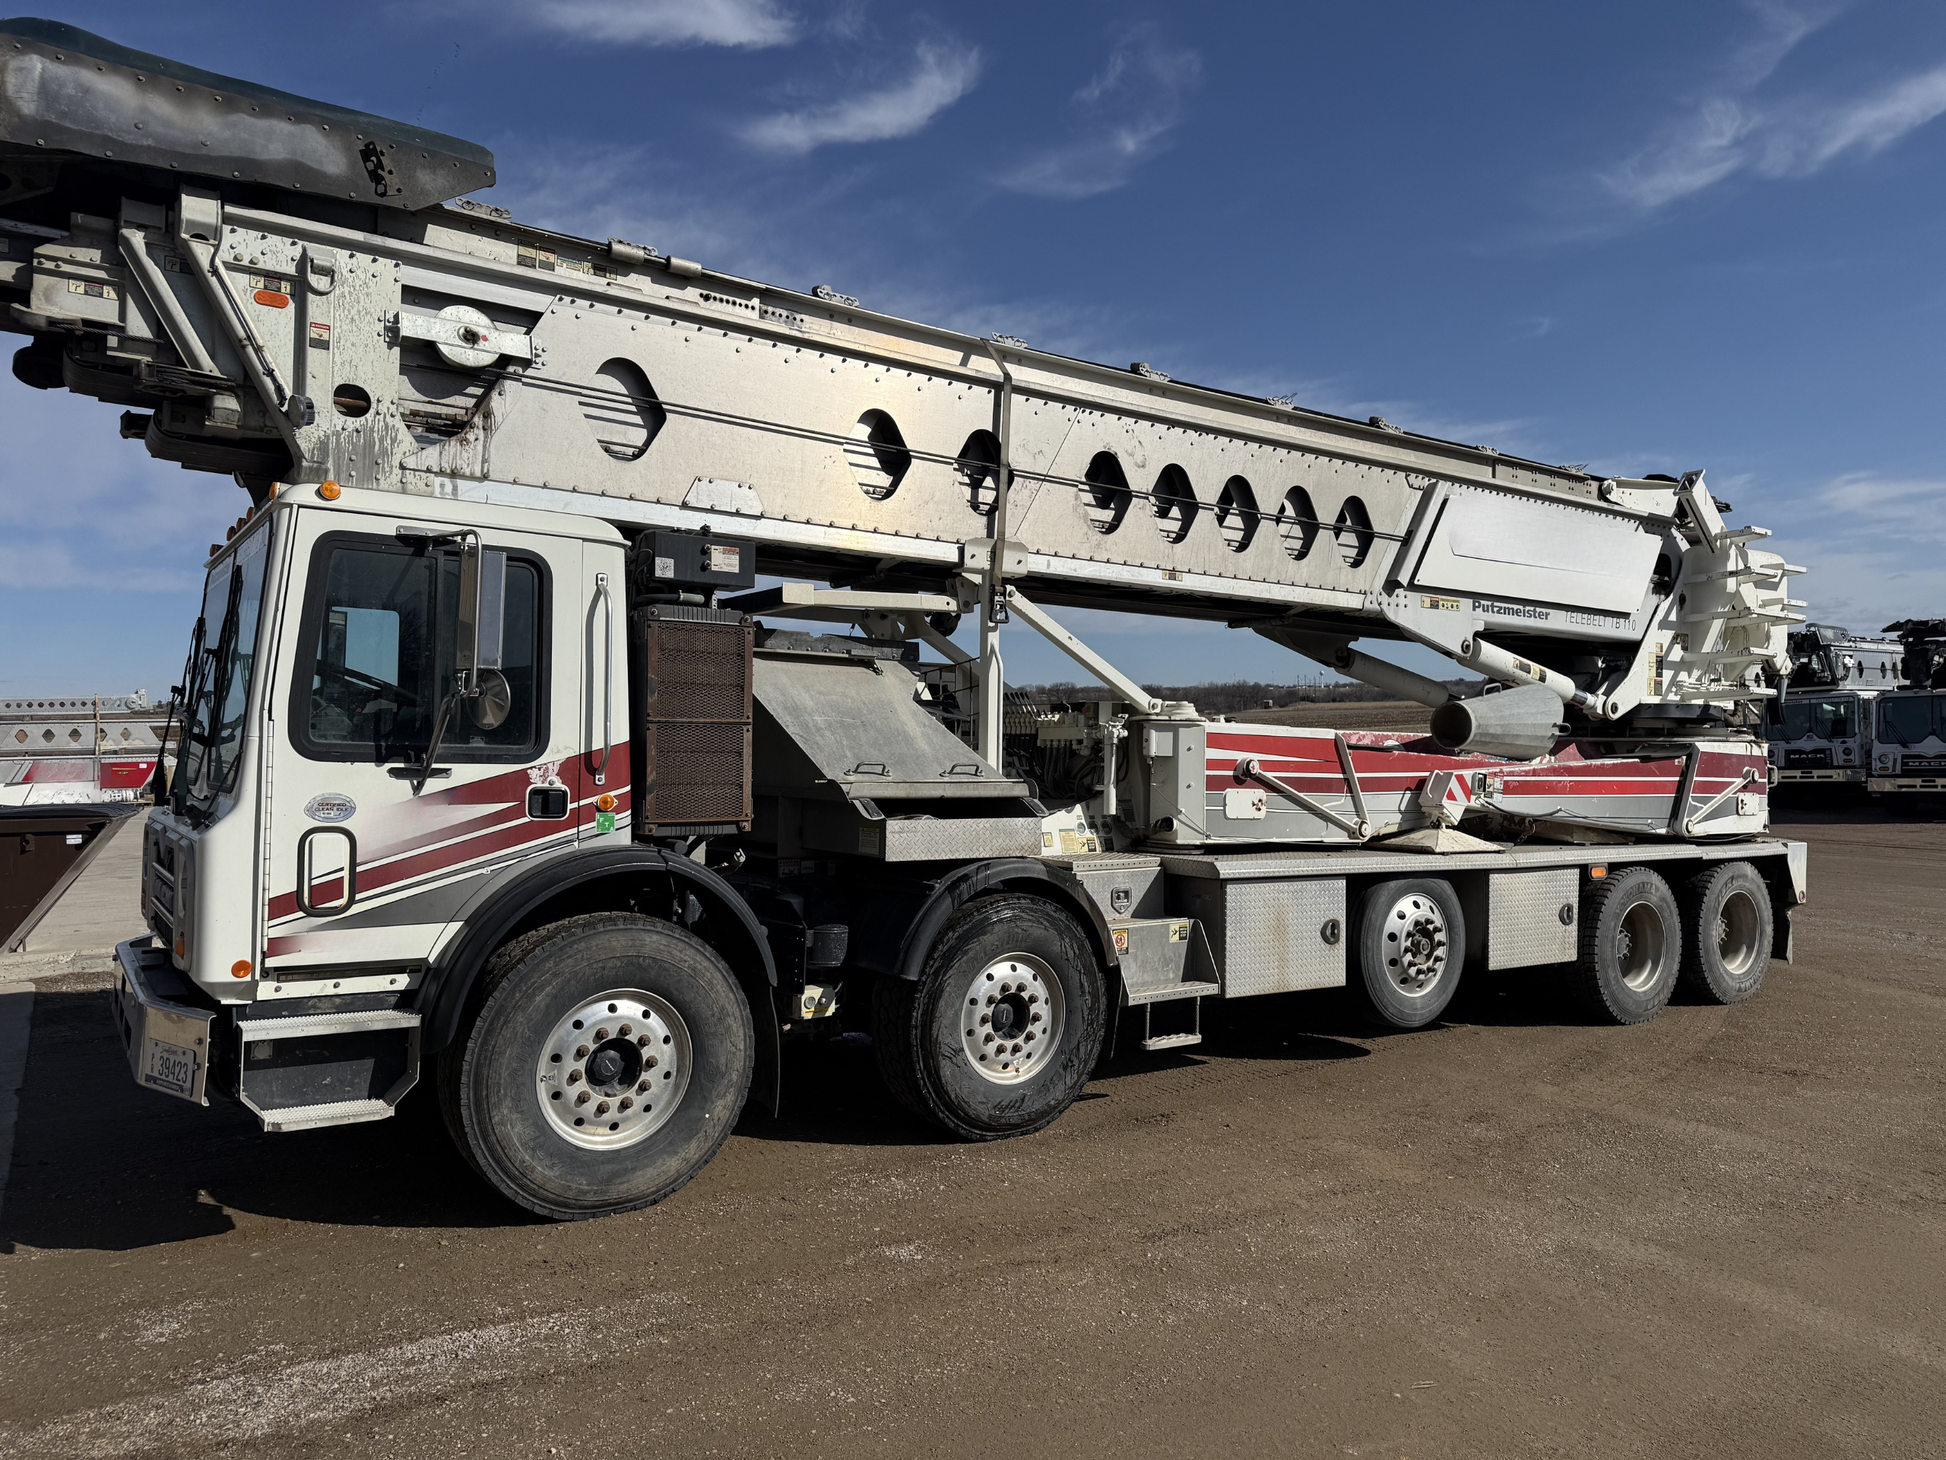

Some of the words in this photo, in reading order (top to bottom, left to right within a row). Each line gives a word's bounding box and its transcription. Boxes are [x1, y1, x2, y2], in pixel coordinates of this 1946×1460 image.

[1472, 599, 1550, 620] Putzmeister
[1565, 610, 1607, 627] TELEBELT
[1611, 616, 1621, 629] TB
[1623, 618, 1637, 631] 110
[158, 1055, 189, 1084] 39423
